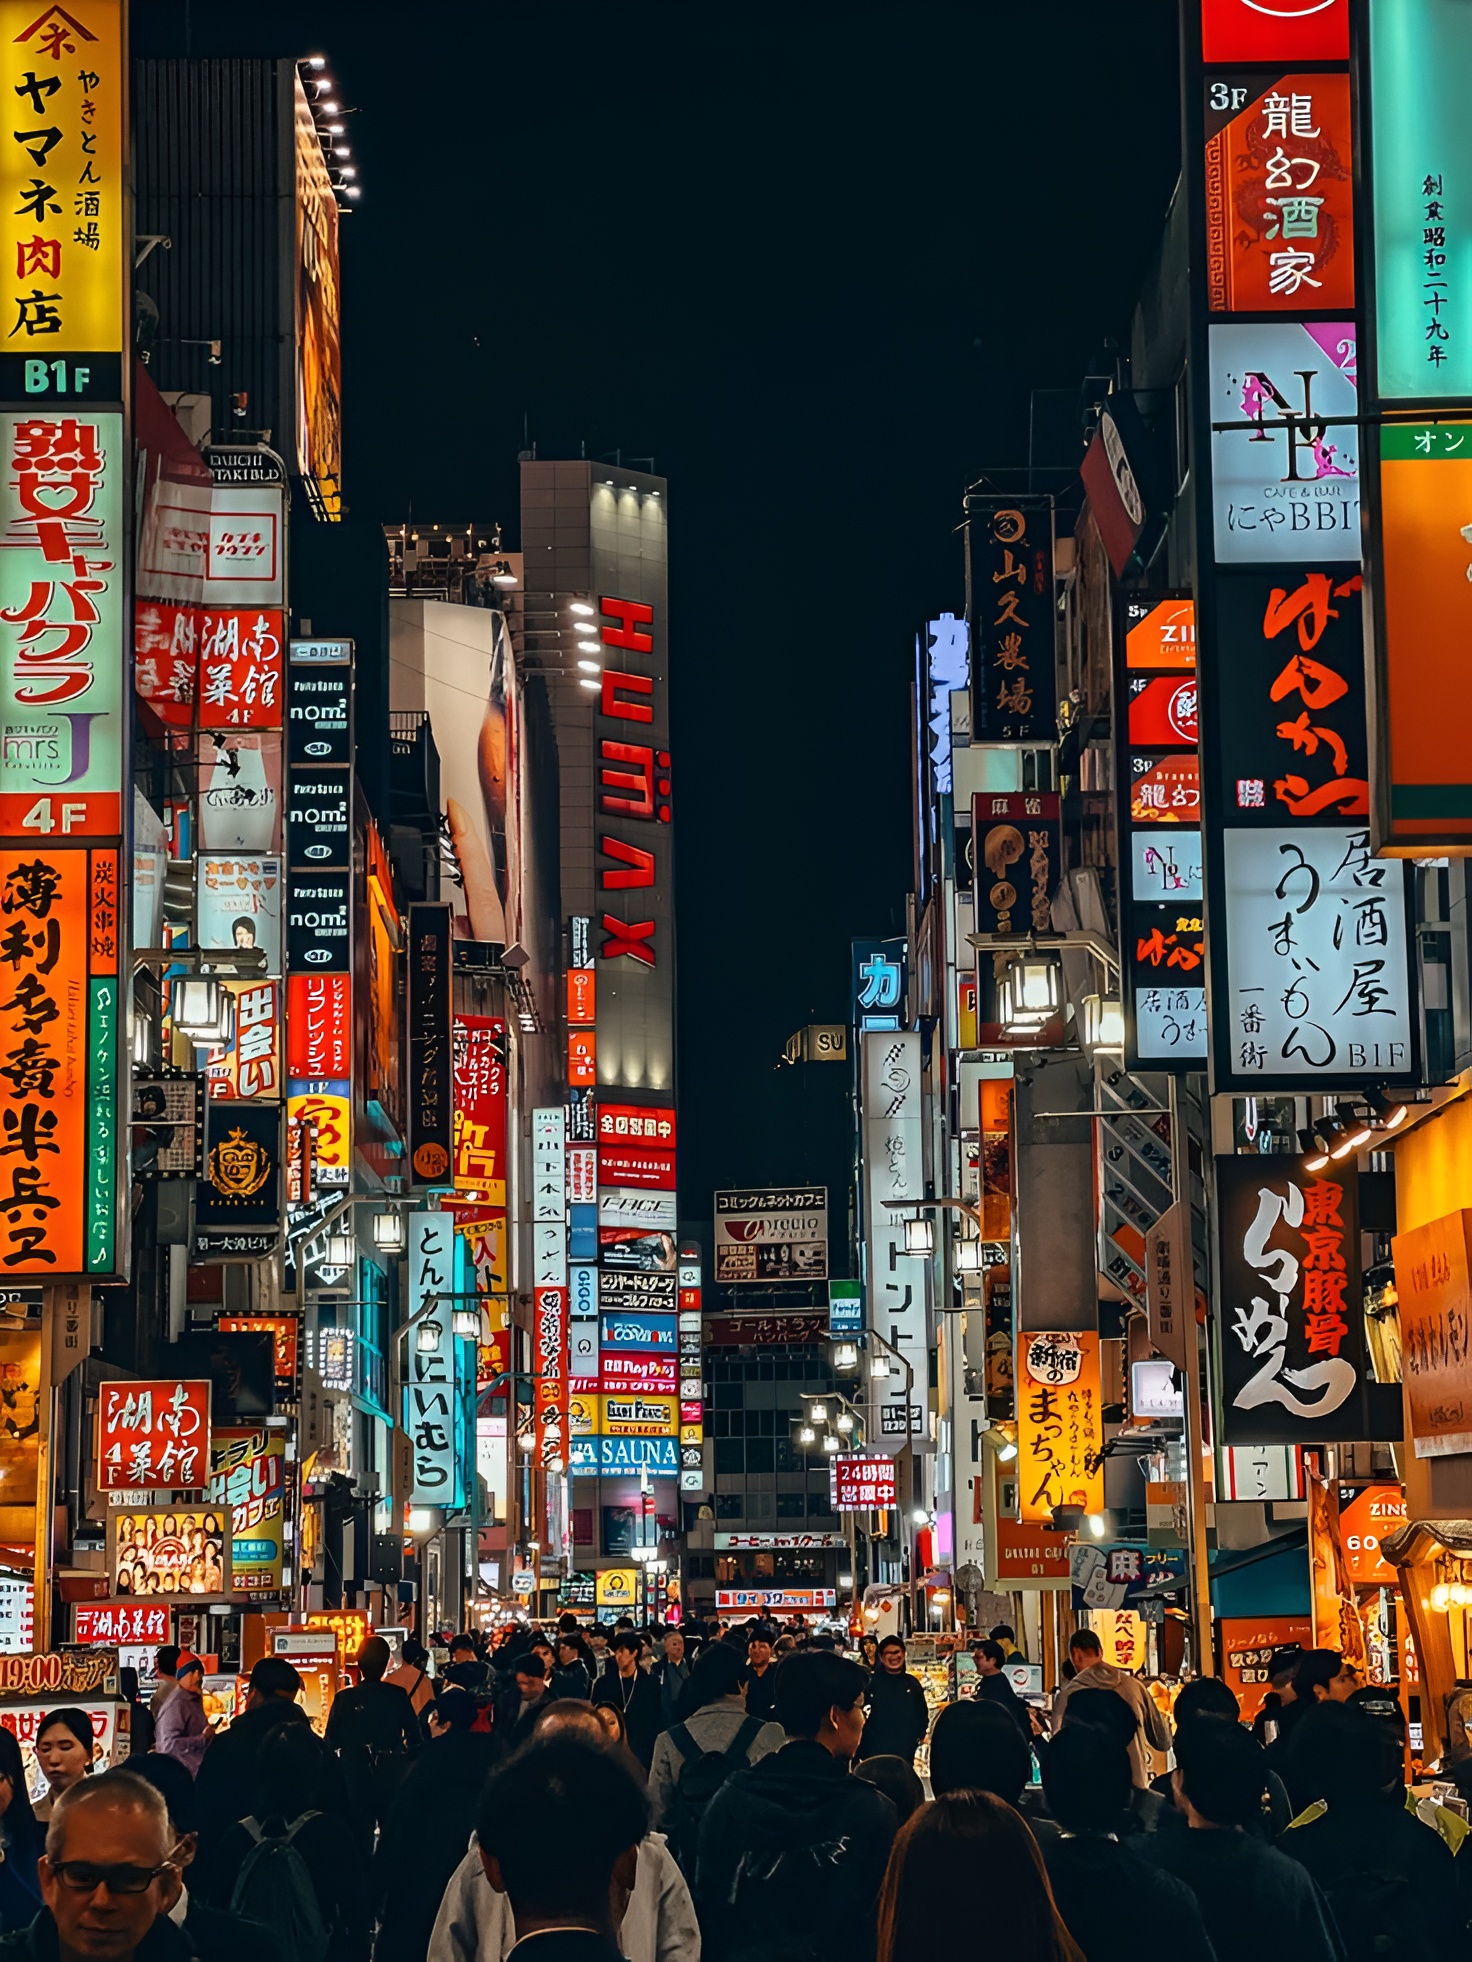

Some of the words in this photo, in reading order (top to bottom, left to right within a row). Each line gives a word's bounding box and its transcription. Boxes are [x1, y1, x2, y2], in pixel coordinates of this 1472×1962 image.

[1210, 83, 1247, 111] 3F
[8, 72, 64, 338] ヤマネ肉店
[73, 69, 101, 252] やきとん酒場
[1261, 91, 1326, 297] 龍幻酒家
[25, 360, 90, 393] B1F
[22, 798, 87, 833] 4F
[601, 595, 672, 969] HUMAX
[1329, 831, 1397, 1018] 居酒屋
[239, 985, 277, 1099] 出会い
[1300, 1178, 1349, 1356] 東京豚骨
[107, 1383, 200, 1438] 湖南
[601, 1440, 678, 1465] SAUNA
[1028, 1388, 1067, 1508] まっちゃん
[1346, 1534, 1379, 1551] 60
